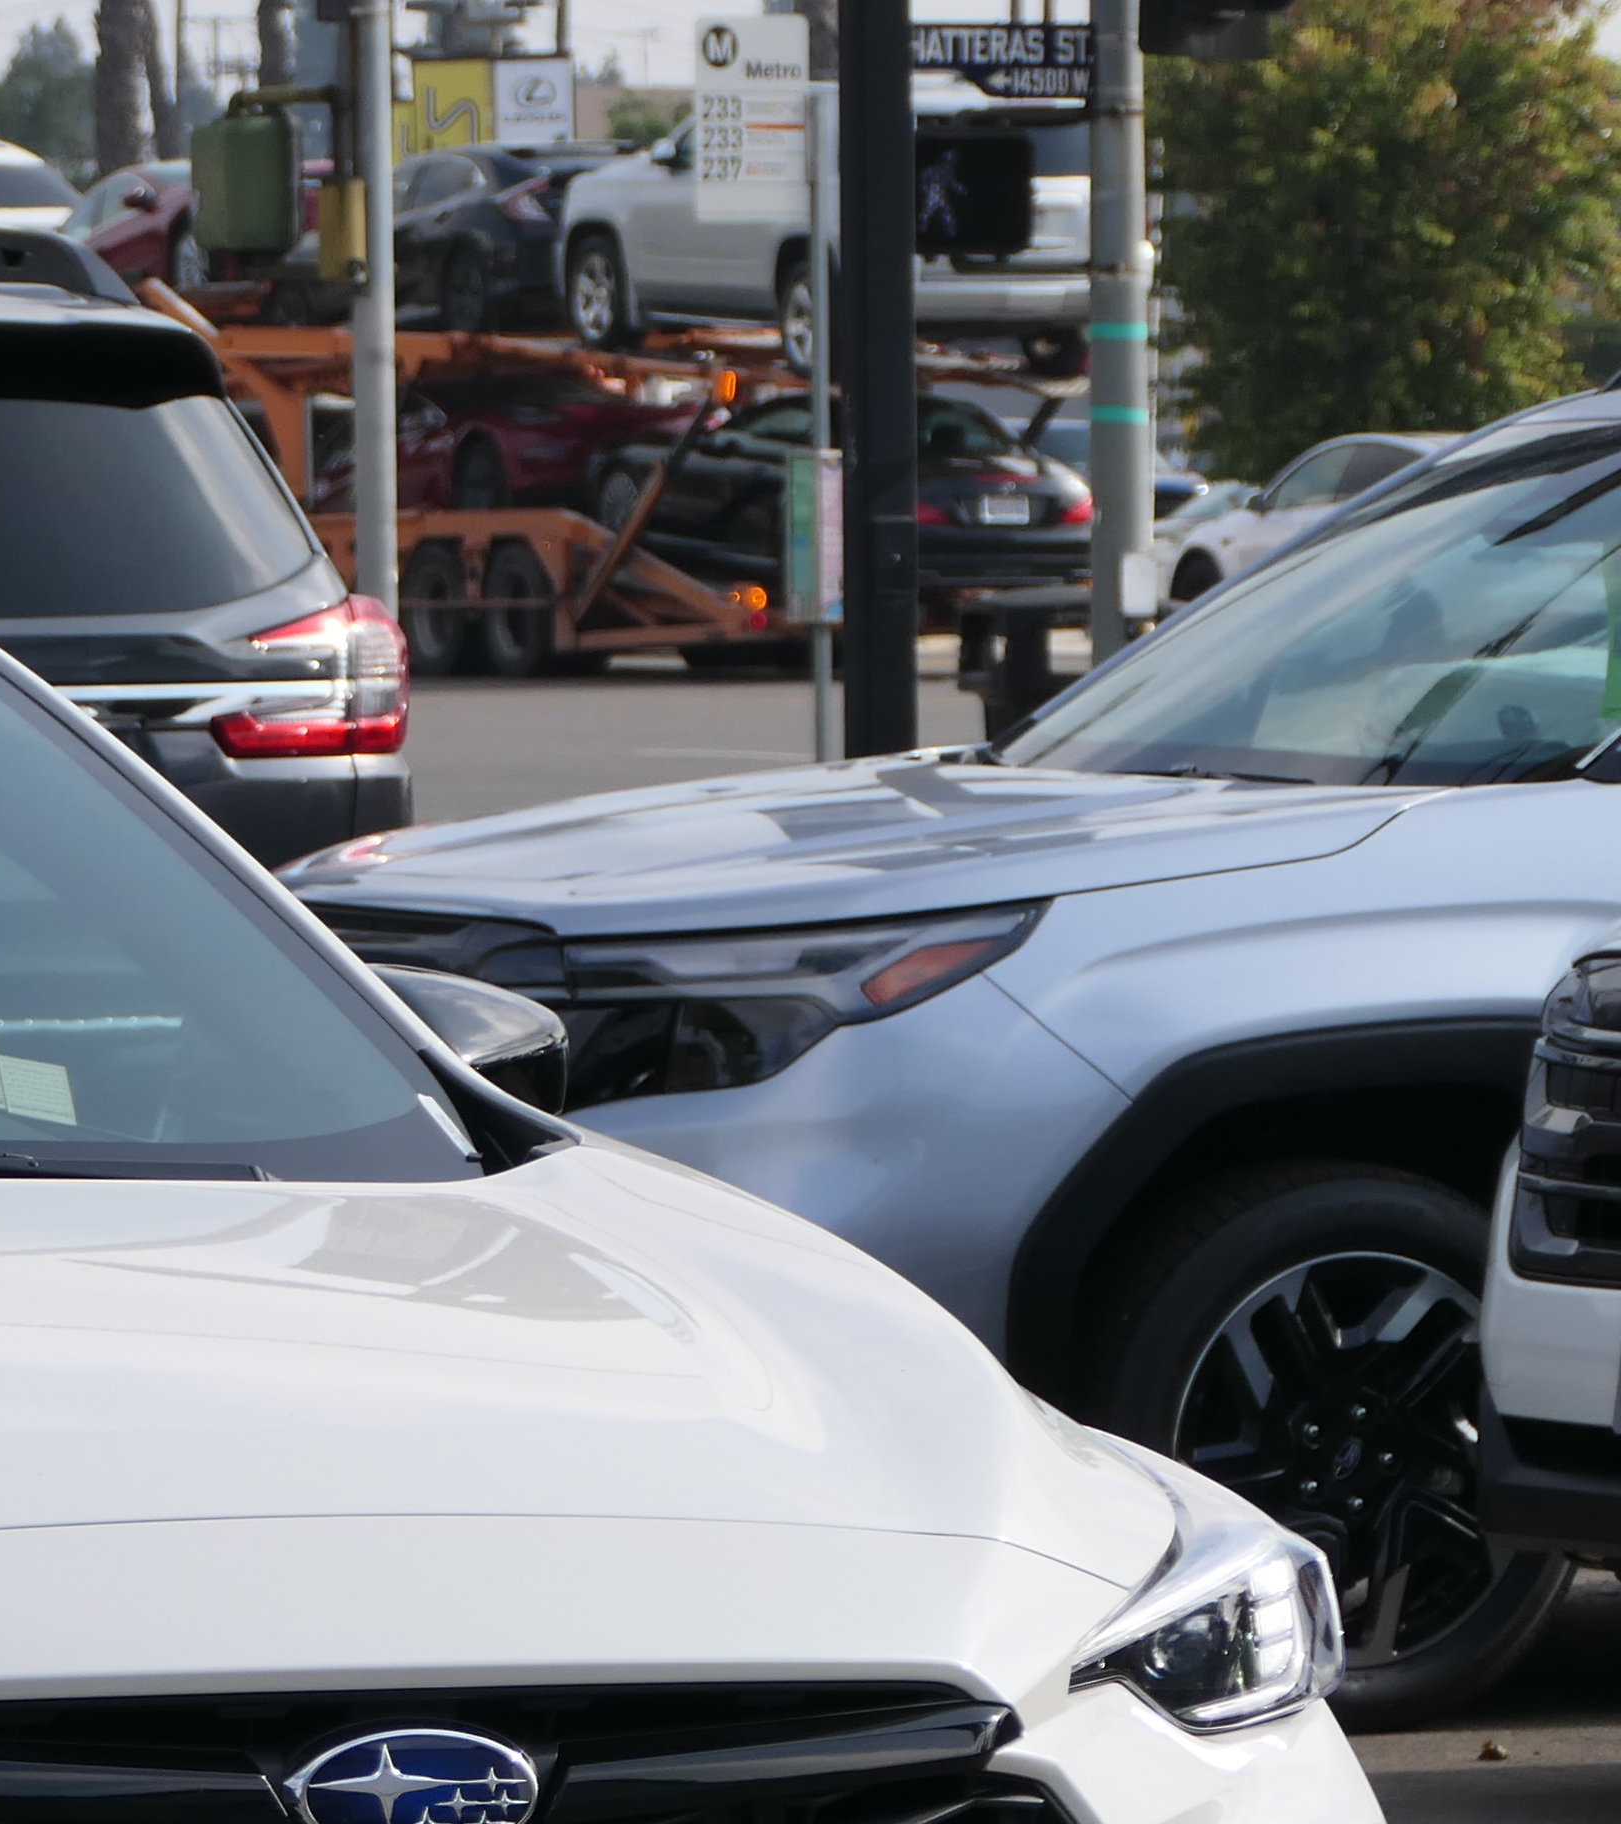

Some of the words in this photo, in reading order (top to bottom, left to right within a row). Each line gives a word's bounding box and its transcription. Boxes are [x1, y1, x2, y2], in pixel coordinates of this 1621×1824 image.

[745, 62, 802, 79] Metro
[1011, 67, 1070, 96] 14500
[702, 95, 743, 119] 233
[702, 126, 743, 150] 233
[702, 155, 742, 181] 237
